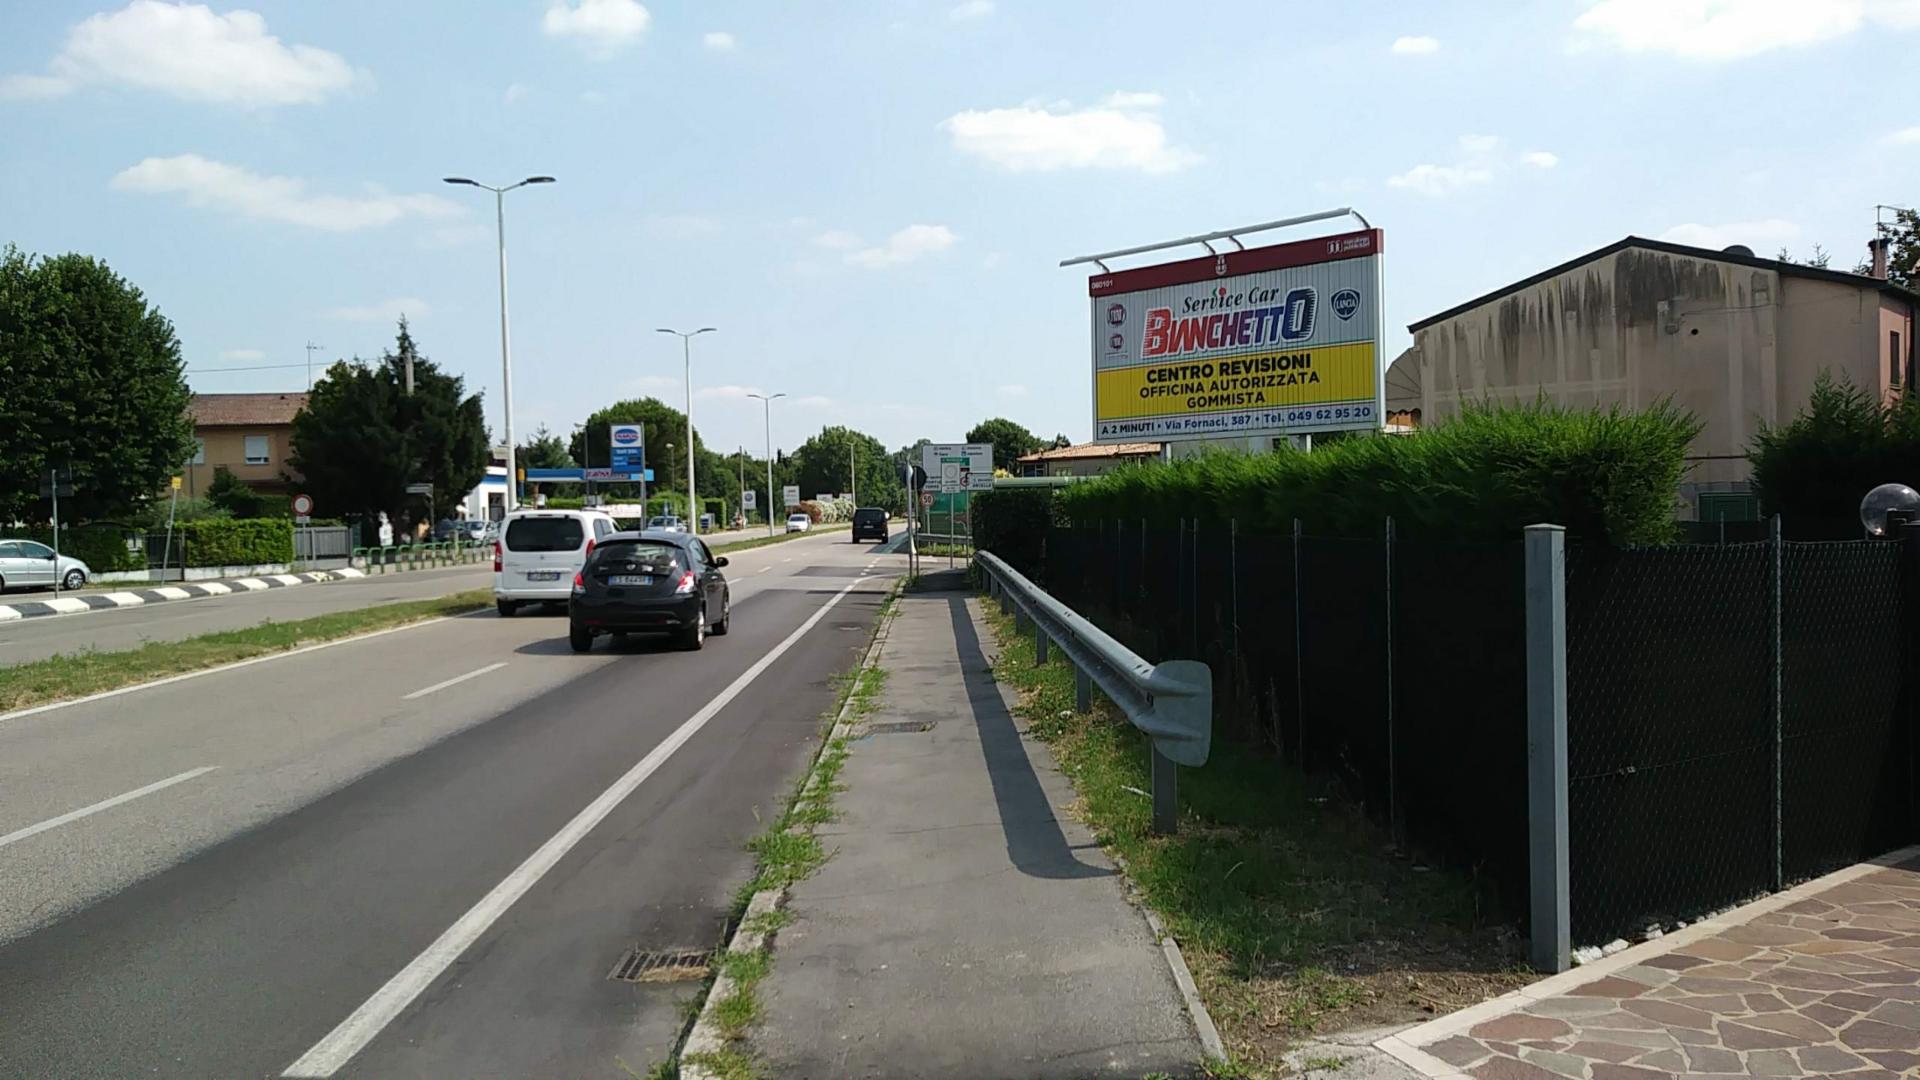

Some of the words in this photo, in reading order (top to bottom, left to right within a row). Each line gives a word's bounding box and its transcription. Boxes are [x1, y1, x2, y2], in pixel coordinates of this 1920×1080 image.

[1182, 287, 1243, 313] Service
[1247, 286, 1280, 305] Car
[1335, 297, 1356, 309] LANCIA
[1141, 286, 1319, 358] BIANCHETTO
[1146, 362, 1214, 384] CENTRO
[1218, 353, 1311, 376] REVISIONI
[1139, 382, 1205, 399] OFFICINA
[1211, 371, 1320, 393] AUTORIZZATA
[1186, 392, 1266, 409] GOMMISTA
[1101, 424, 1110, 435] A
[1111, 424, 1118, 434] 2
[1119, 421, 1155, 434] MINUTI
[1165, 419, 1182, 430] Via
[1184, 415, 1229, 430] Fornaci,
[1231, 414, 1251, 426] 387
[1264, 413, 1285, 424] Tel.
[1288, 410, 1312, 422] 049
[1316, 408, 1332, 420] 62
[1334, 408, 1351, 419] 95
[1353, 406, 1371, 418] 20
[923, 495, 932, 503] 50
